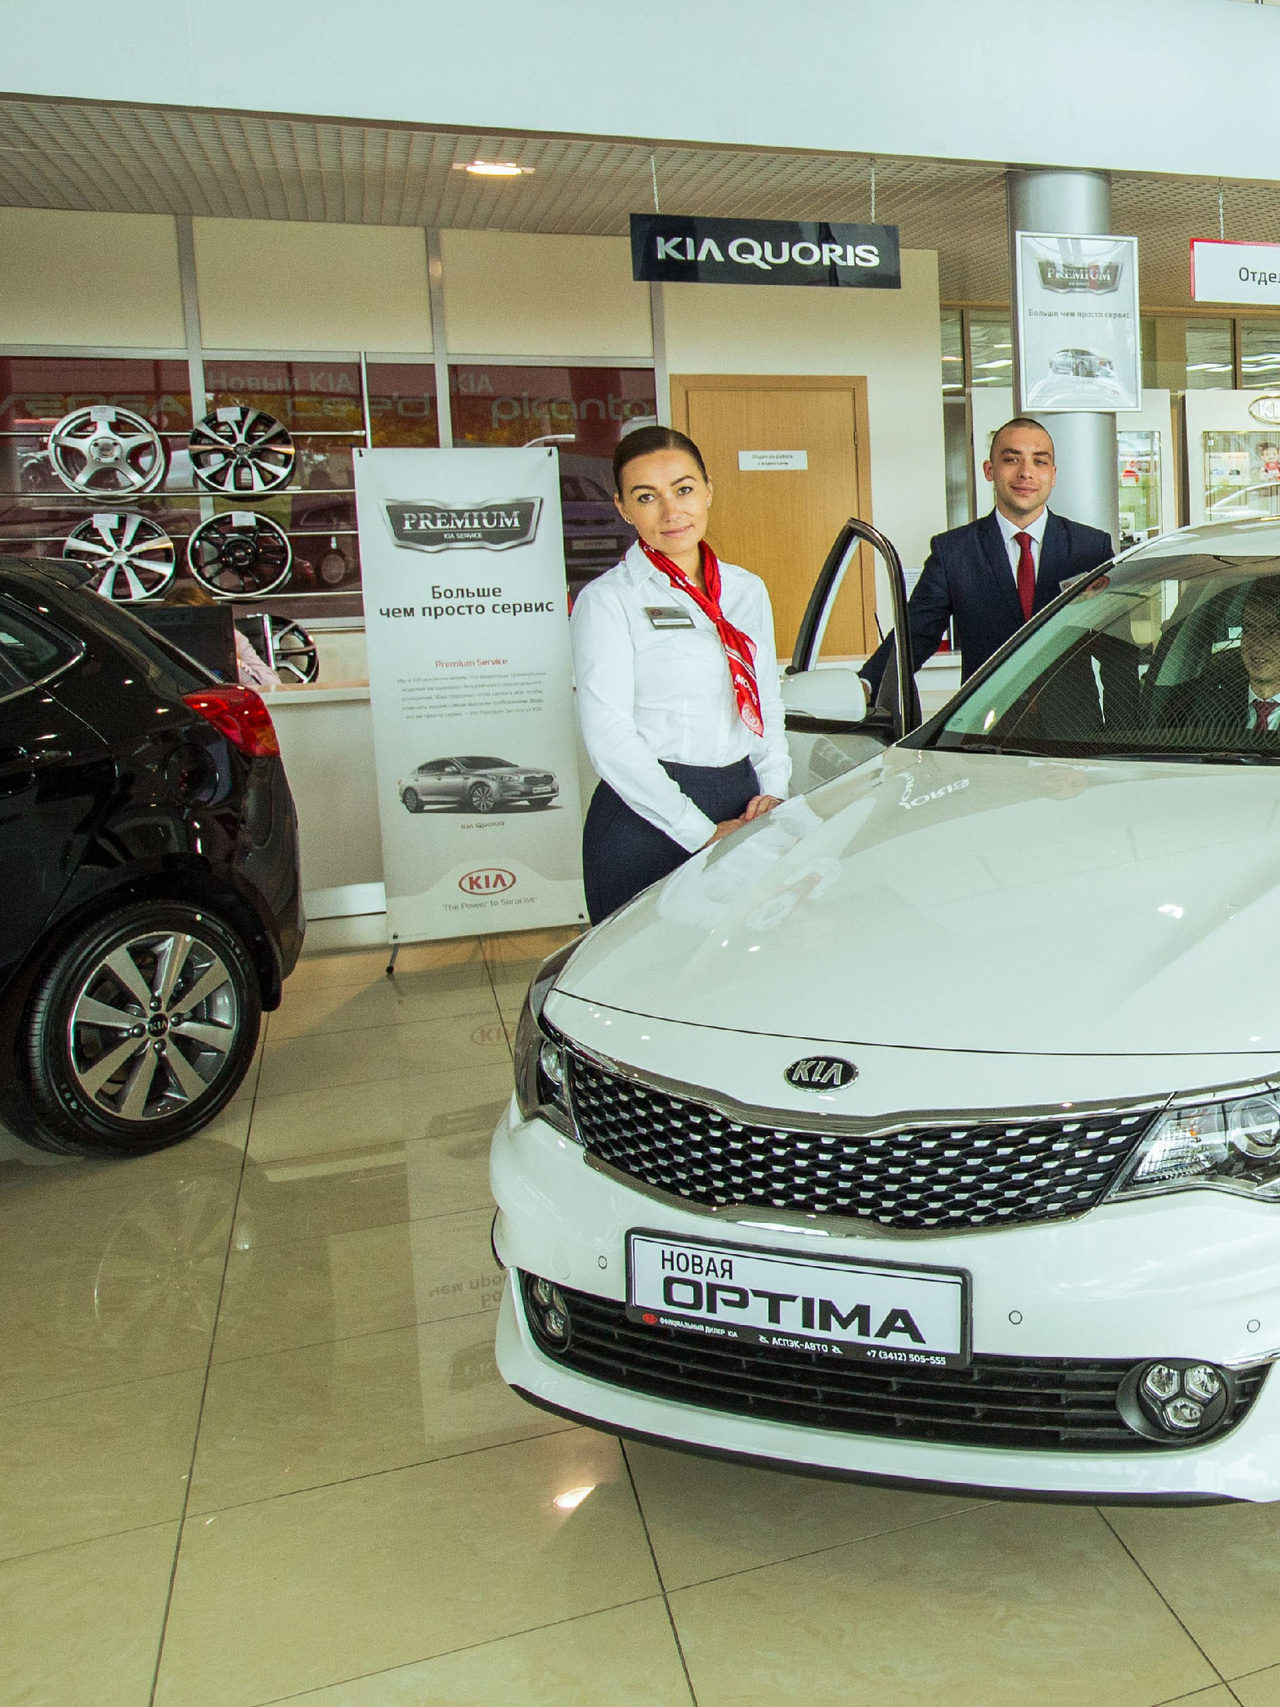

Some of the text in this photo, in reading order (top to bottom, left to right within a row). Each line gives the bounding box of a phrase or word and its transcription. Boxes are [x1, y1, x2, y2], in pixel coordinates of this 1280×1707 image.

[657, 236, 880, 270] KIA QUORIS
[1047, 267, 1111, 280] PREMIUM
[1028, 308, 1059, 317] Больше
[208, 371, 298, 392] Новый
[490, 391, 651, 430] picanto
[402, 510, 521, 530] PREMIUM
[431, 585, 502, 599] Больше
[379, 600, 555, 620] чем просто сервис
[435, 658, 508, 668] Premium Service
[468, 873, 508, 891] KIA
[443, 904, 459, 912] The
[460, 901, 487, 911] Power
[490, 899, 499, 907] to
[792, 1060, 843, 1085] KIA
[661, 1249, 733, 1280] НОВАЯ
[663, 1276, 926, 1344] OPTIMA
[660, 1317, 704, 1331] ОФИЦИАЛЬНЫЙ
[704, 1325, 725, 1336] ДИЛЕР
[772, 1337, 828, 1353] АСПЭК-АВТО
[866, 1349, 947, 1366] +7 (3412) 505-555
